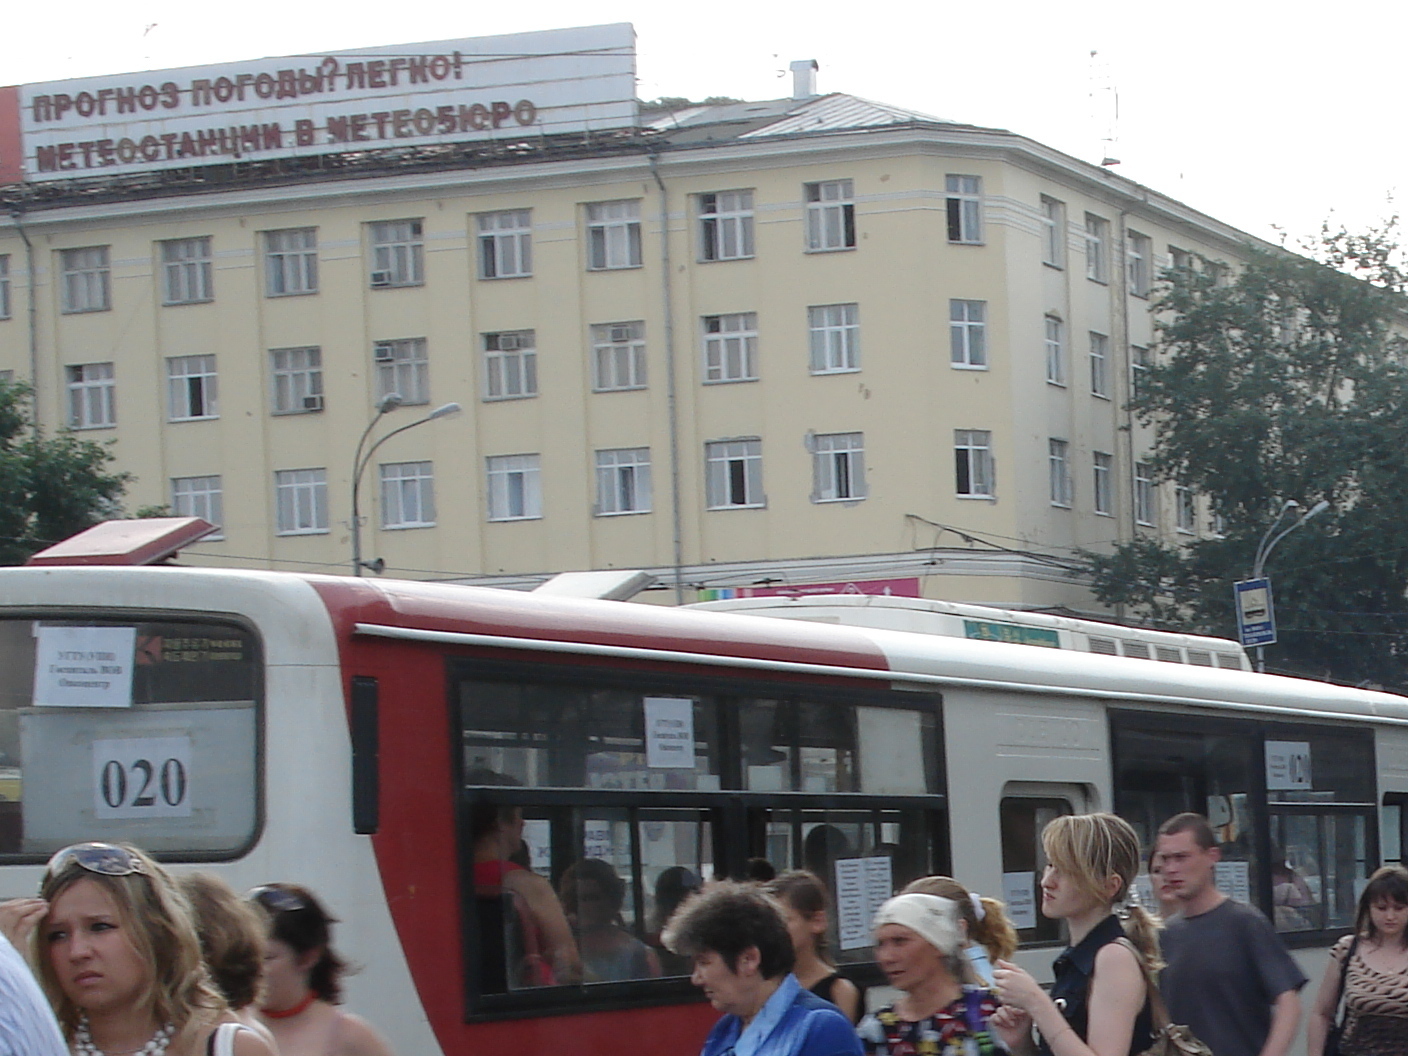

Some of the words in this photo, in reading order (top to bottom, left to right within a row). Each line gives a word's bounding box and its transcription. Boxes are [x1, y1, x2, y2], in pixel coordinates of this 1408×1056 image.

[33, 82, 181, 122] ПРОГНОЗ
[191, 56, 339, 107] ПОГОДЫ?
[346, 51, 462, 90] ЛЕГКО!
[36, 122, 282, 172] МЕТЕОСТАНЦИИ
[295, 119, 314, 147] В
[327, 99, 536, 144] МЕТЕОБЮРО
[102, 758, 187, 808] 020
